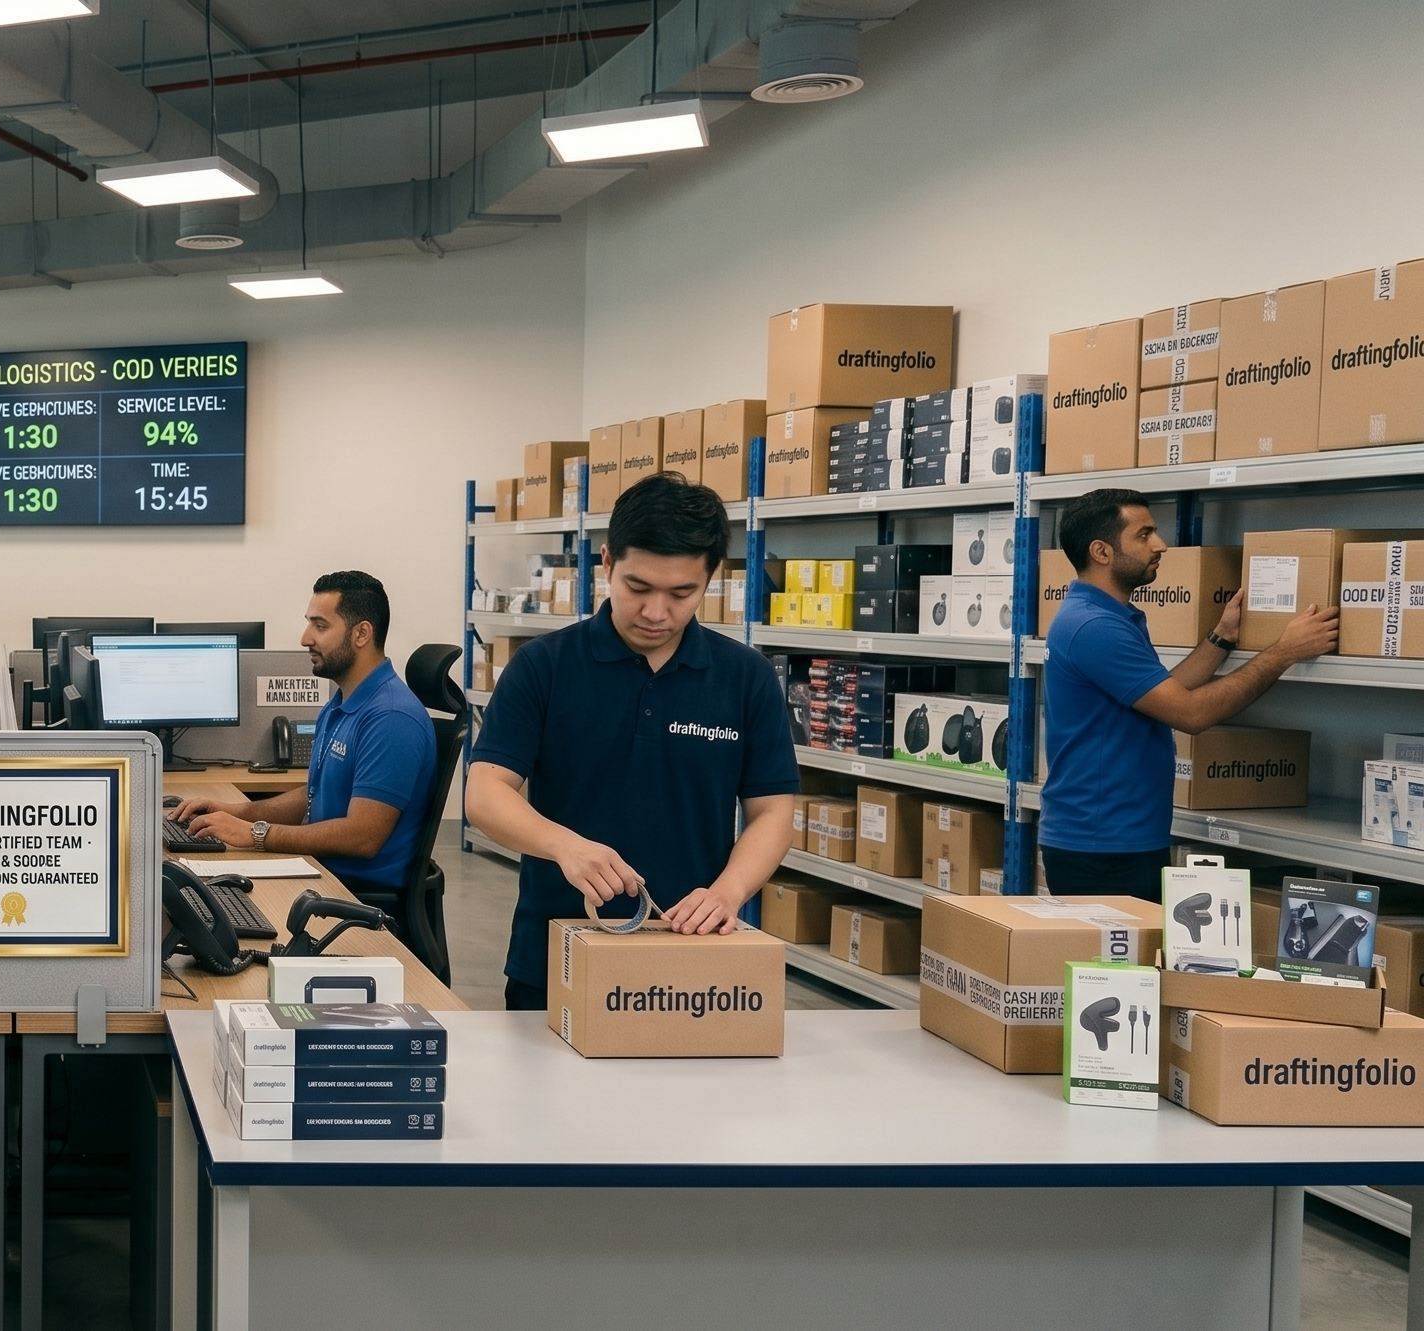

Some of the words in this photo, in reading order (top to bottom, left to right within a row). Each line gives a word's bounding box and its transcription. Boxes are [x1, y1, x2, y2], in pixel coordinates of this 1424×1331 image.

[113, 359, 154, 381] COD
[160, 355, 237, 378] VERIEIS
[837, 349, 936, 372] draftingfolio
[1226, 355, 1312, 387] draftingfolio
[117, 397, 176, 414] SERVICE
[179, 396, 226, 412] LEVEL:
[1053, 382, 1127, 411] draftingfolio
[4, 424, 57, 449] 1:30
[143, 420, 198, 447] 94%
[151, 463, 190, 477] TIME:
[4, 487, 58, 512] 1:30
[134, 486, 208, 511] 15:45
[669, 721, 739, 741] draftingfolio
[1207, 759, 1296, 783] draftingfolio
[46, 836, 82, 849] TEAM
[1, 855, 10, 867] &
[21, 873, 99, 884] GUARANTEED
[606, 985, 763, 1018] draftingfolio
[1003, 990, 1037, 1005] CASH
[1244, 1057, 1417, 1093] draftingfolio
